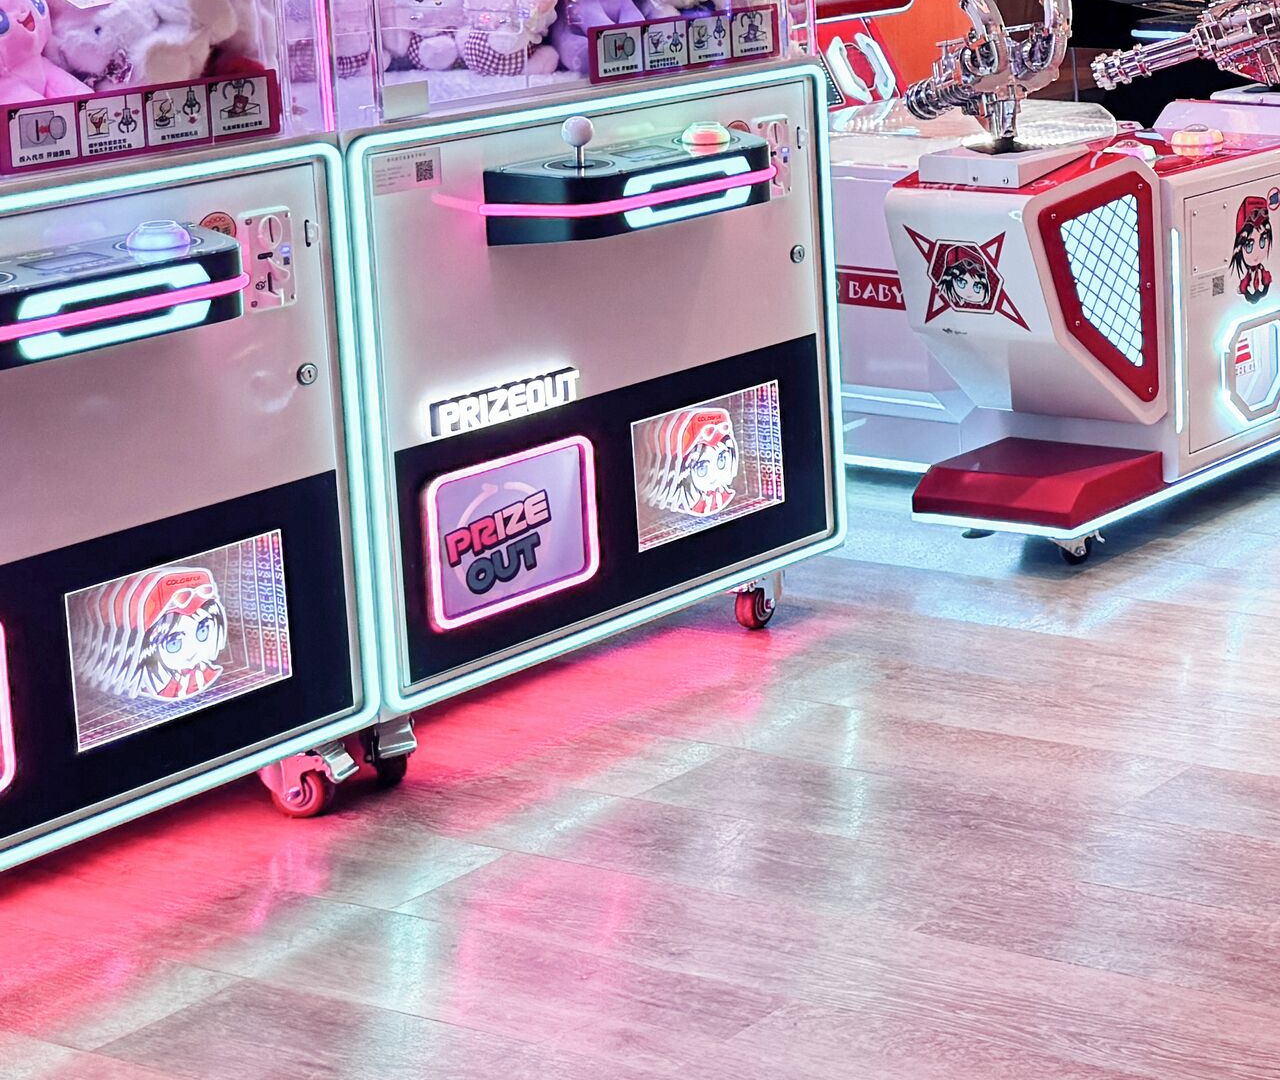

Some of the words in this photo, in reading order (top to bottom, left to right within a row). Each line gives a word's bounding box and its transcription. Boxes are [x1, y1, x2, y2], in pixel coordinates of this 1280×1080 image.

[849, 280, 904, 304] BABY
[437, 369, 580, 437] PRIZEOUT
[444, 489, 552, 568] PRIZE
[466, 532, 541, 595] OUT
